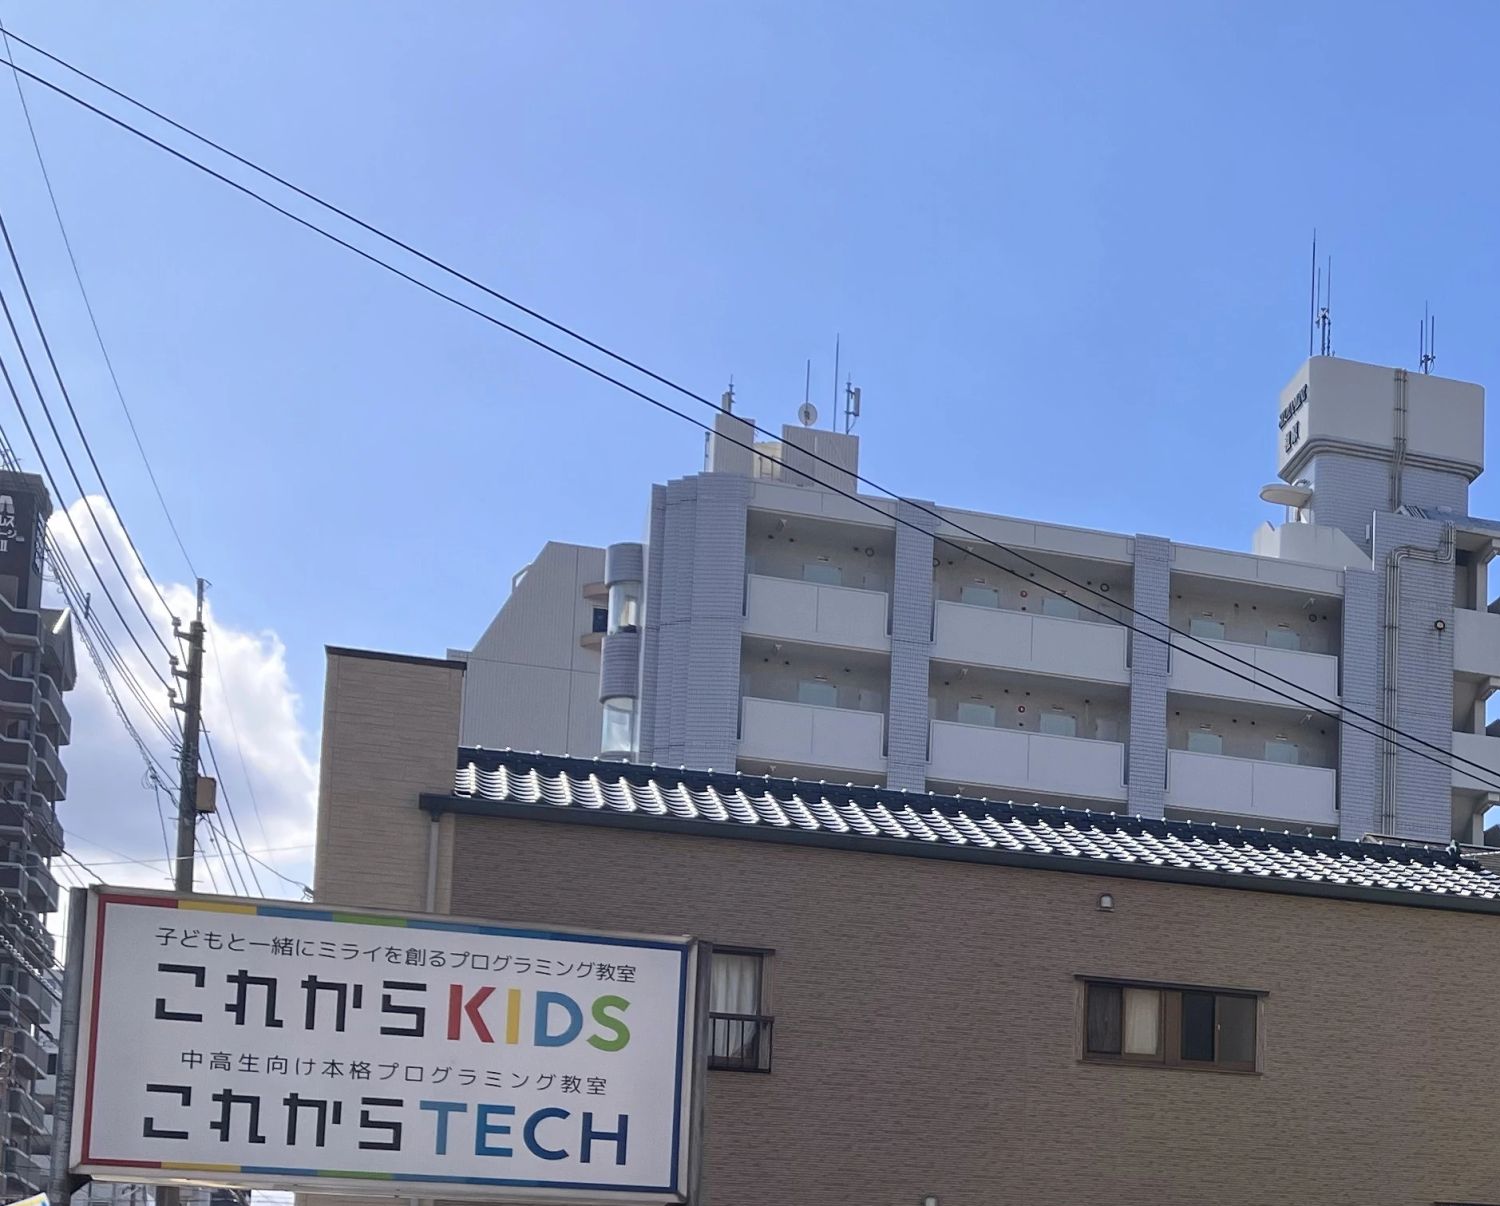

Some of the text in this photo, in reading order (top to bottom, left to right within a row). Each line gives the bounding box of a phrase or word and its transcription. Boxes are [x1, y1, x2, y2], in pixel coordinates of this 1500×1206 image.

[155, 926, 636, 984] 子どもと一緒にミライを創るプログラミング教室
[154, 962, 631, 1053] これからKIDS
[180, 1050, 608, 1096] 中高生向け本格プログラミング教室
[143, 1083, 629, 1166] これからTECH
